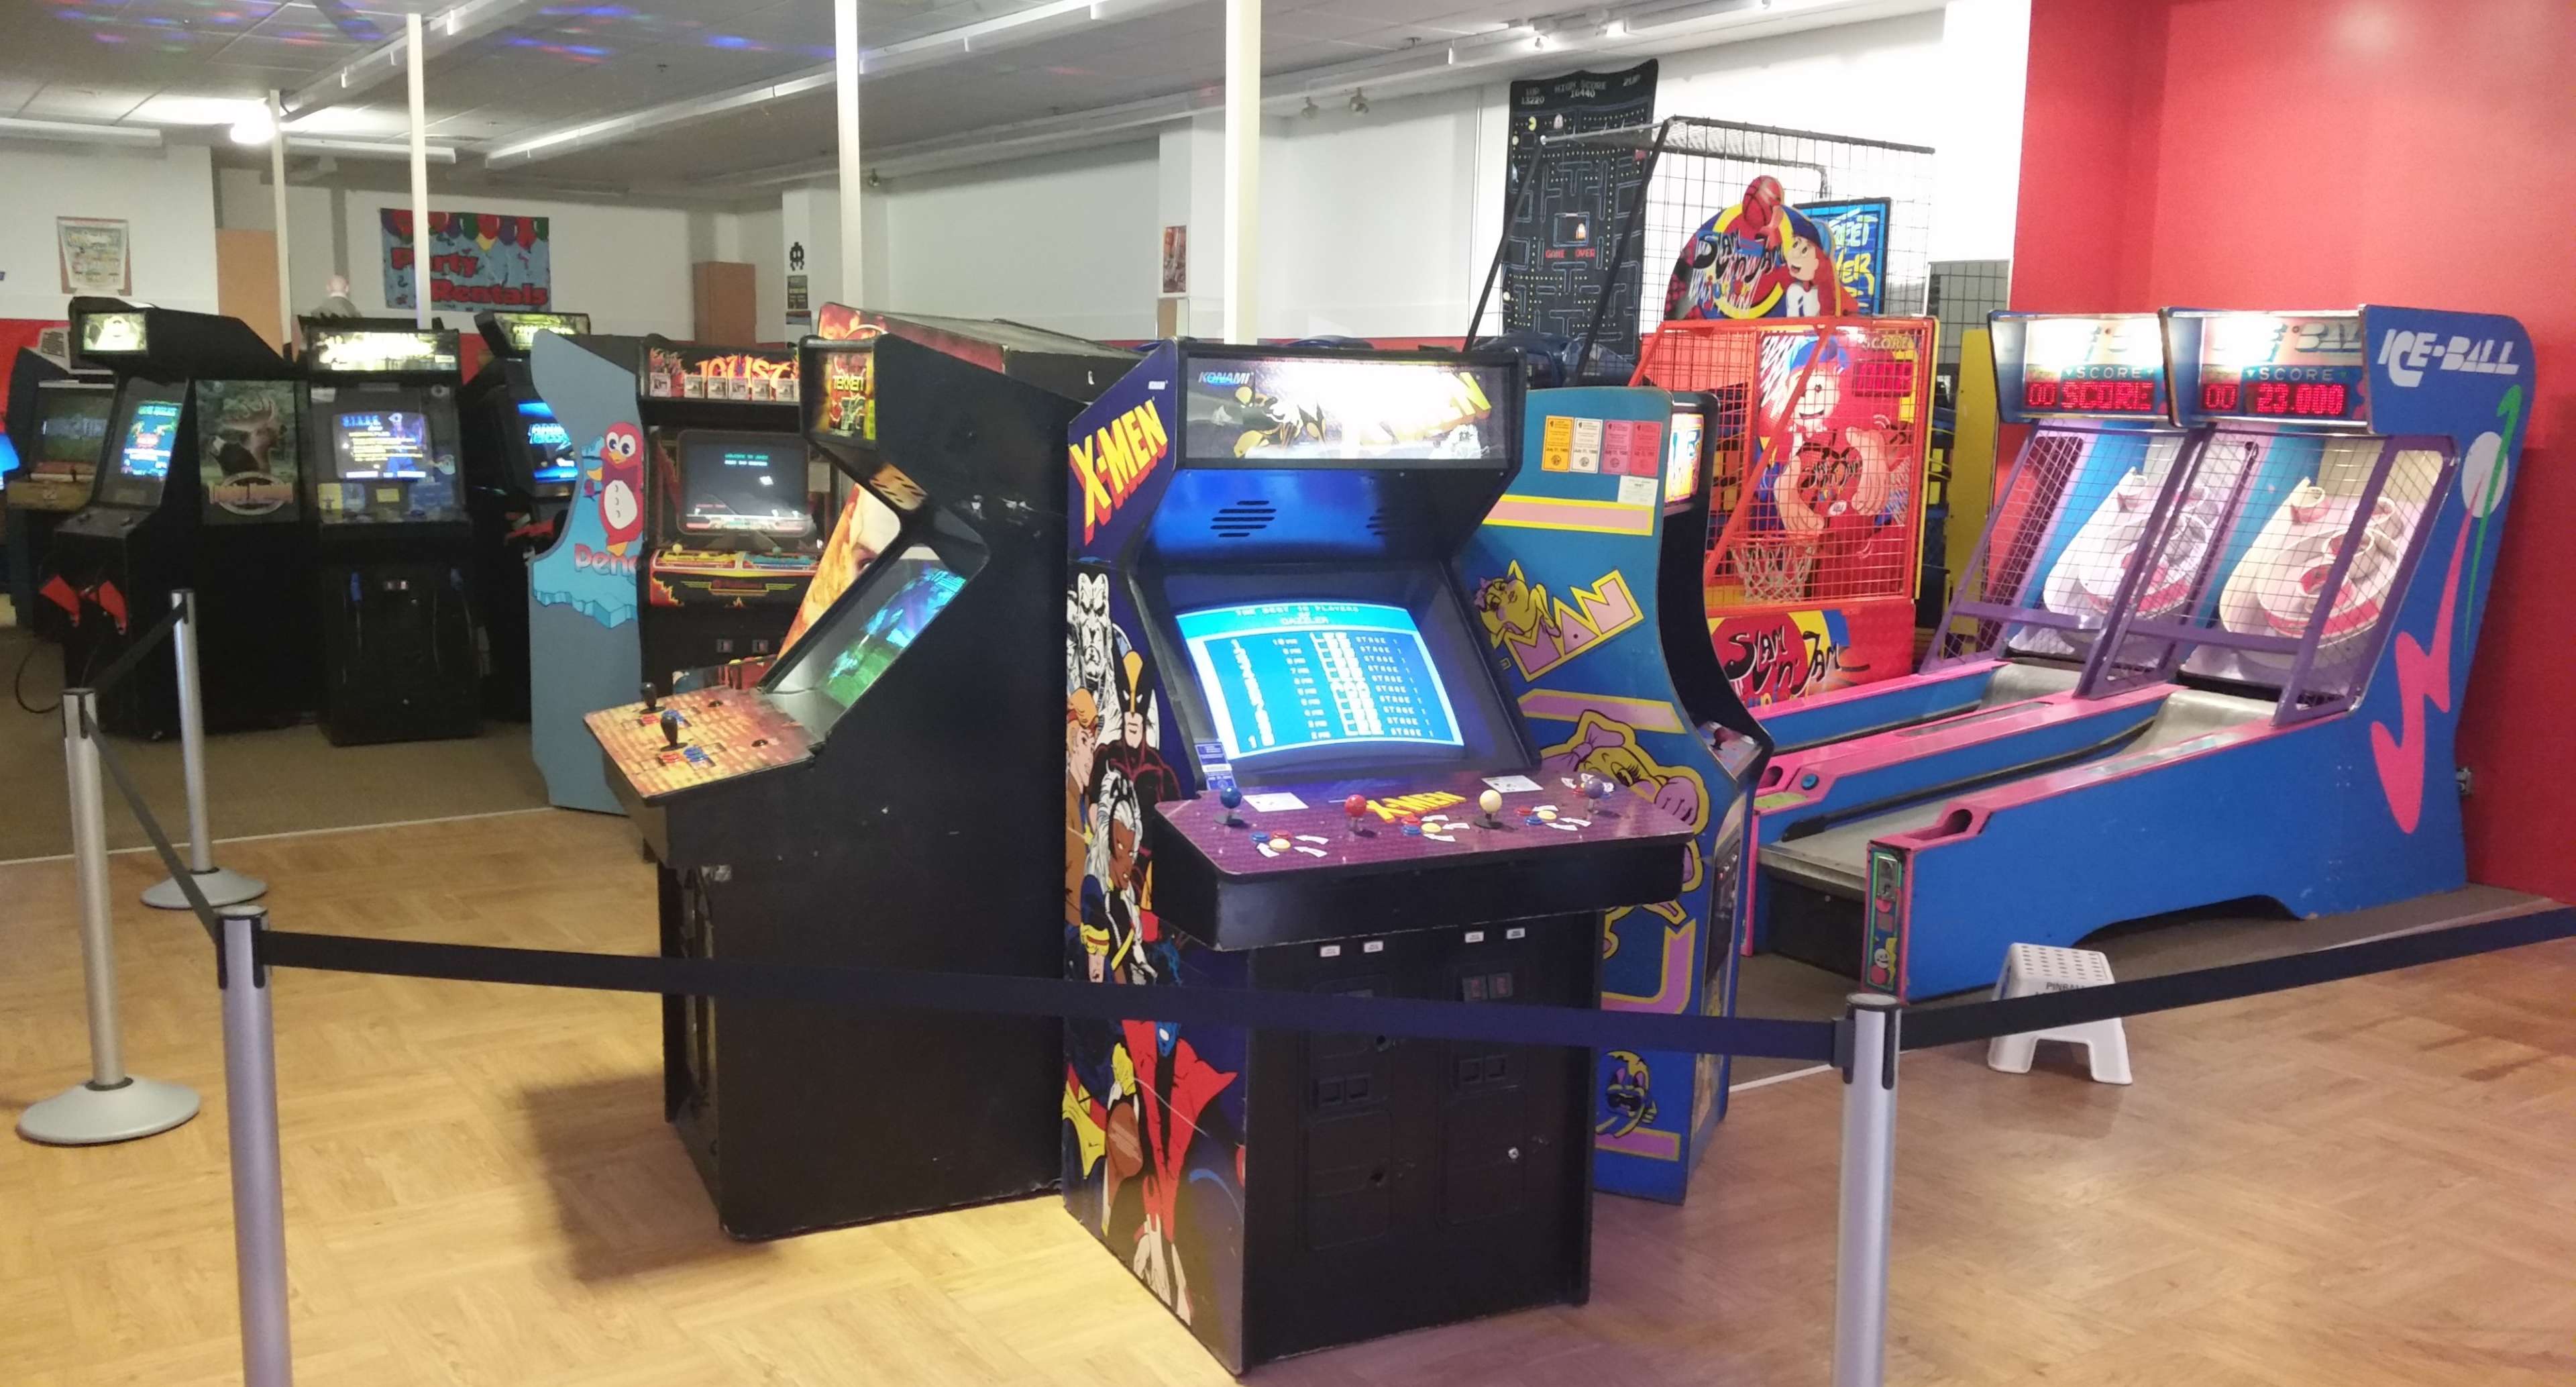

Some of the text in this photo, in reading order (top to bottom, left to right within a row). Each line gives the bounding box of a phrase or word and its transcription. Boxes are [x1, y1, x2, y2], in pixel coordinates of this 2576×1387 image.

[1525, 87, 1540, 96] 1UP
[1554, 80, 1607, 93] HIGH SCORE
[1570, 89, 1596, 99] 16440
[1521, 96, 1545, 105] 13220
[1545, 248, 1595, 258] GAME OVER
[390, 247, 478, 278] Prty
[430, 278, 548, 306] Rentals
[695, 354, 791, 389] JOUST
[2076, 366, 2142, 379] SCORE
[2259, 367, 2334, 382] SCORE
[832, 374, 864, 391] TEKKEN
[1198, 371, 1250, 385] KONAMI
[2061, 380, 2153, 411] SCORE
[1069, 398, 1169, 546] X-MEN
[1262, 606, 1289, 614] BEST
[1504, 569, 1644, 682] MAN
[1355, 636, 1386, 644] STAGE
[1360, 646, 1390, 654] STAGE
[1364, 655, 1394, 664] STAGE
[1368, 665, 1399, 673] STAGE
[1371, 675, 1403, 683] STAGE
[1375, 685, 1407, 693] STAGE
[1379, 695, 1410, 704] STAGE
[1383, 706, 1415, 715] STAGE
[1387, 717, 1418, 725] STAGE
[1391, 727, 1422, 737] STAGE
